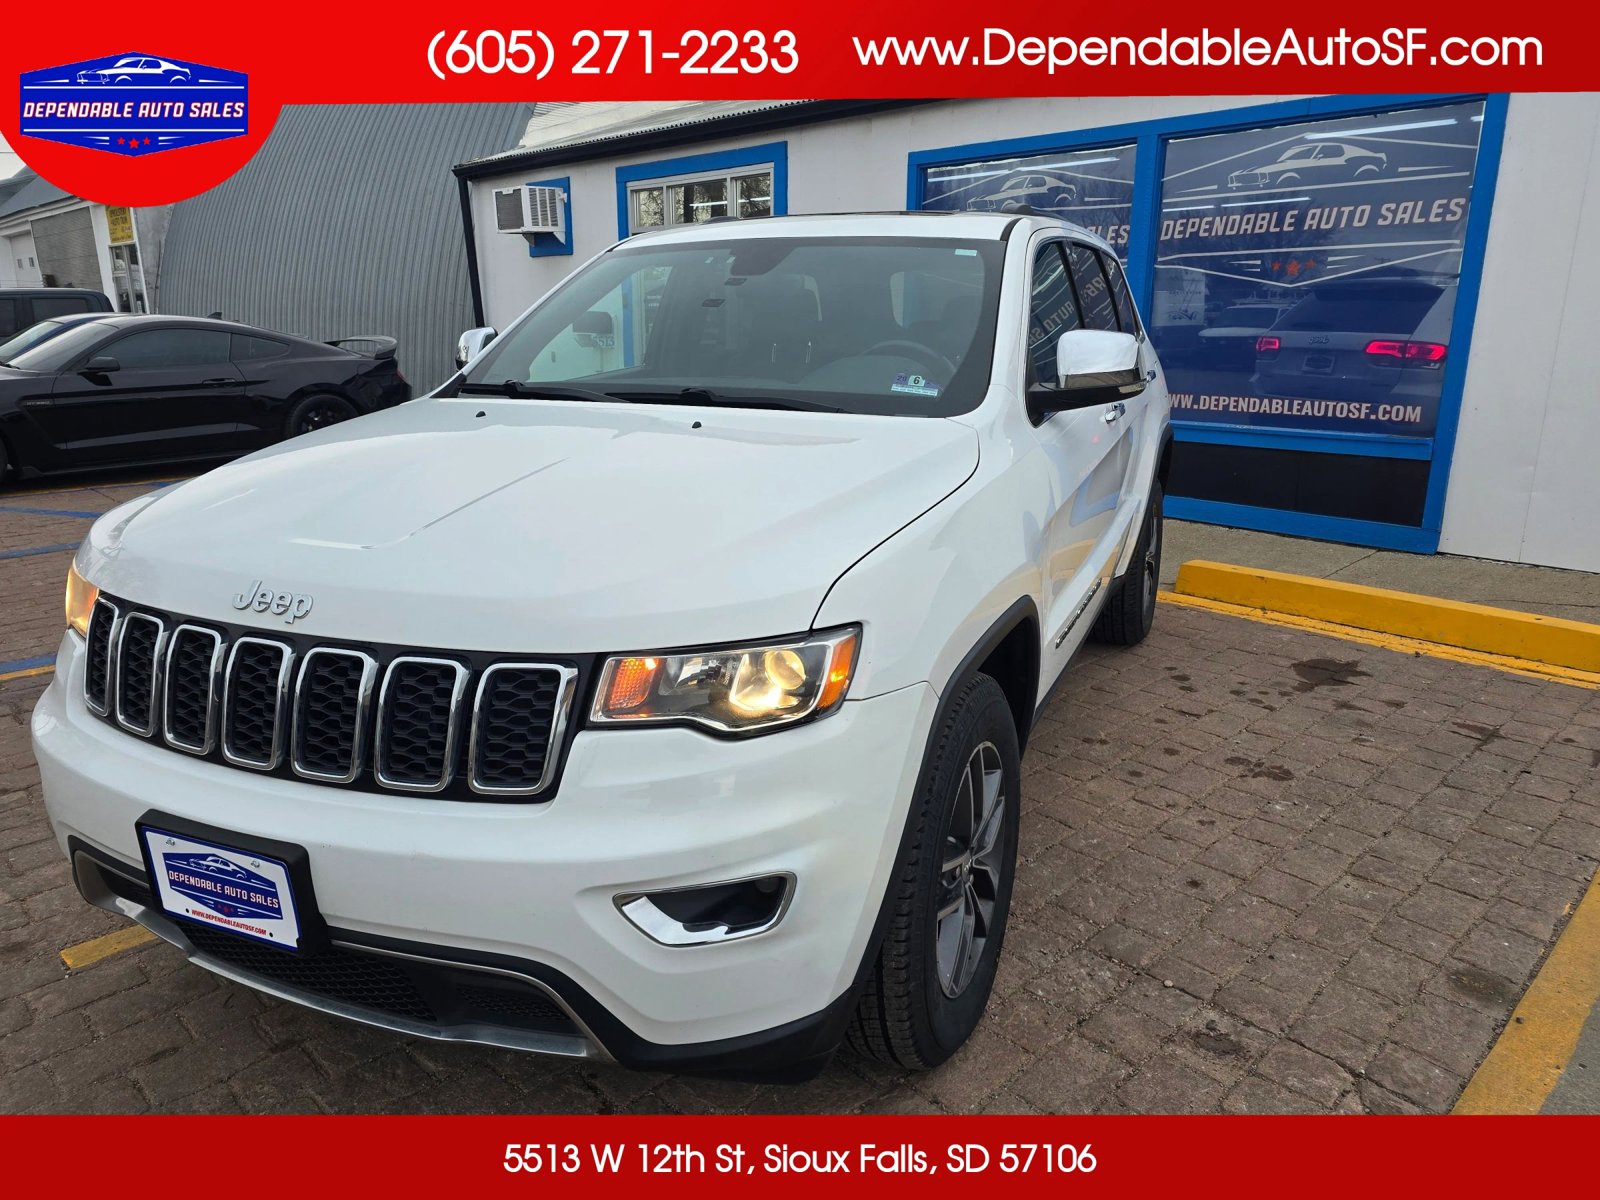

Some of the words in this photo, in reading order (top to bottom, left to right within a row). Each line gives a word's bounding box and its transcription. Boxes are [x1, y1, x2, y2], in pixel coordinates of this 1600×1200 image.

[1160, 209, 1298, 240] DEPENDABLE
[1303, 204, 1371, 230] AUTO
[1377, 198, 1466, 226] SALES
[913, 376, 921, 385] 6
[232, 579, 314, 625] Jeep
[168, 870, 223, 893] DEPENDABLE
[224, 885, 248, 900] AUTO
[250, 892, 279, 909] SALES
[191, 908, 267, 935] WWW.DEPENDABLEAUTOSF.COM
